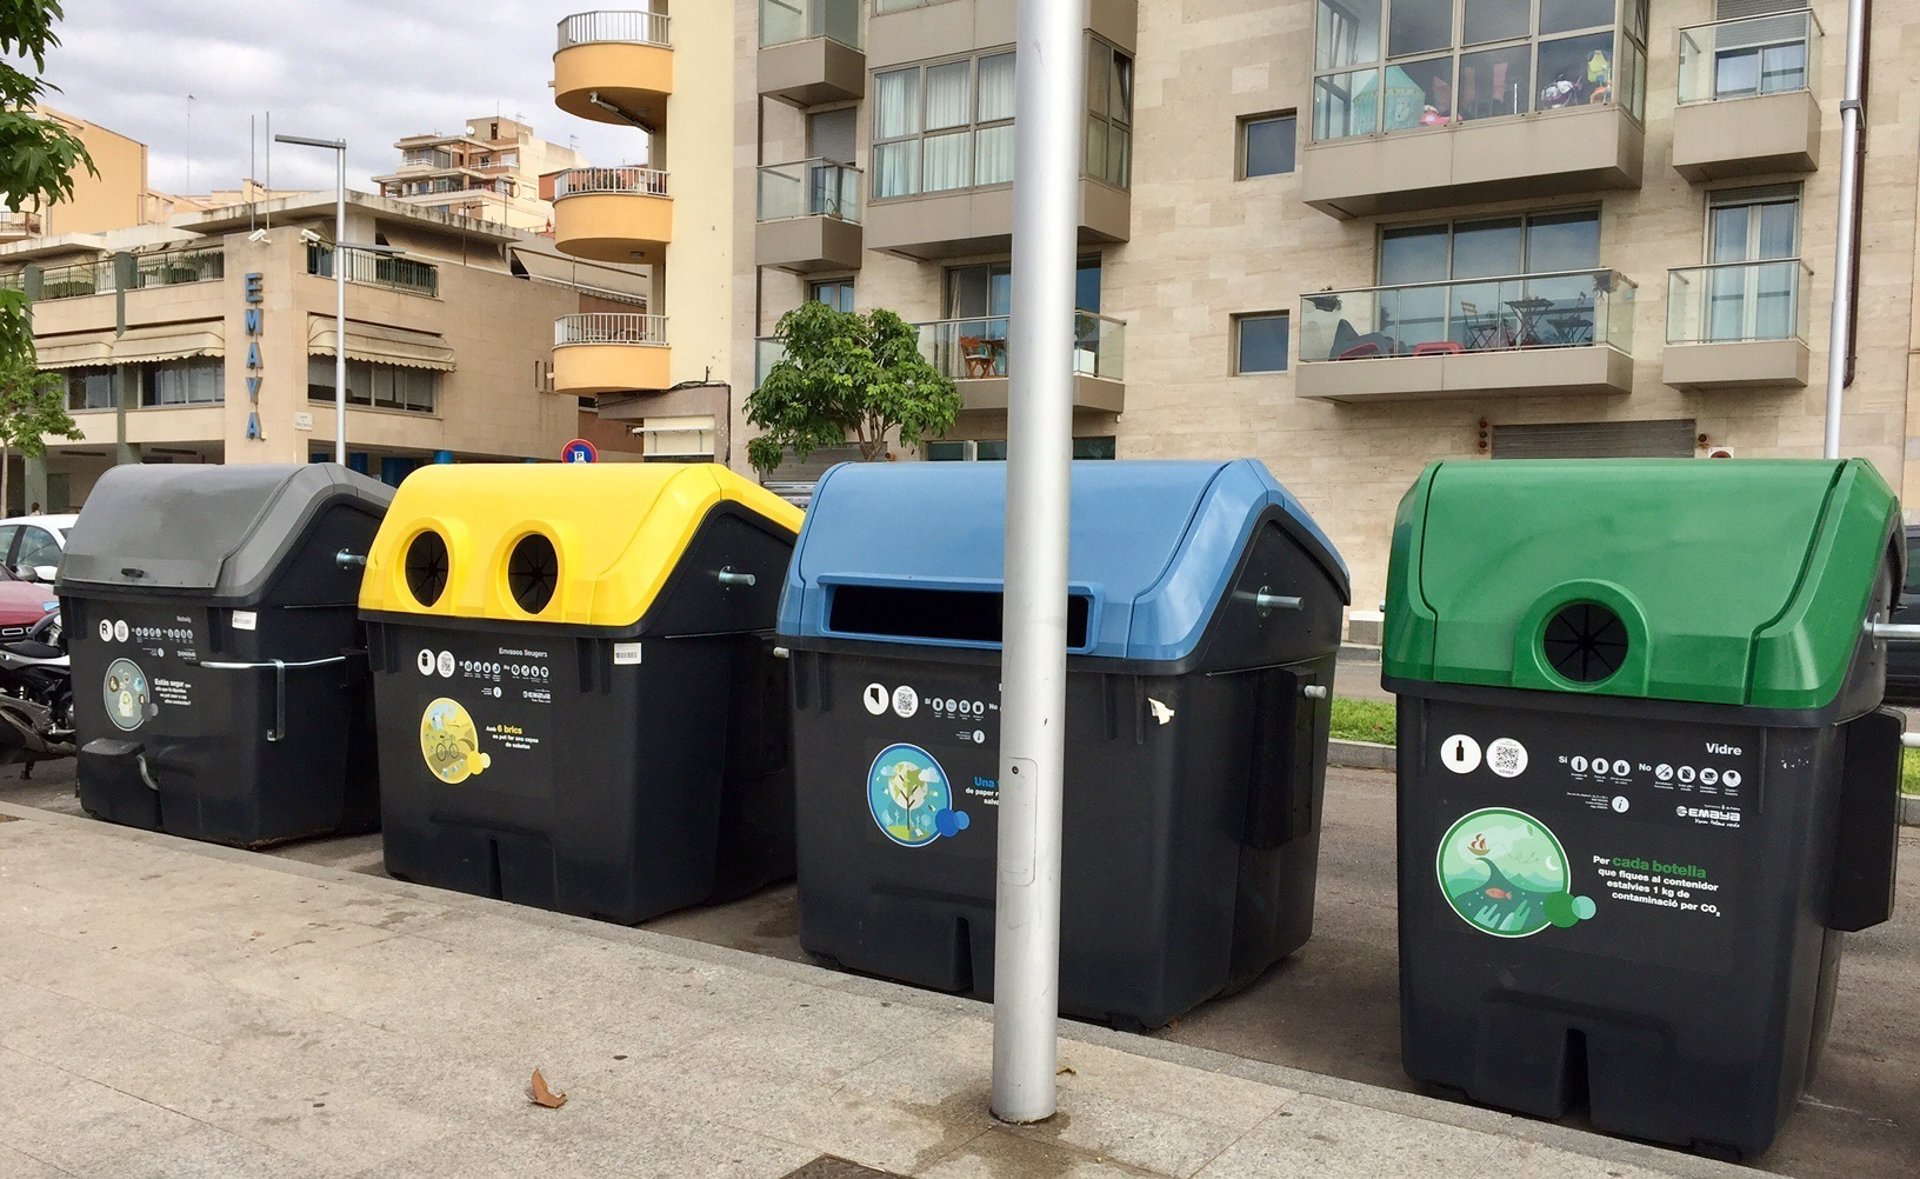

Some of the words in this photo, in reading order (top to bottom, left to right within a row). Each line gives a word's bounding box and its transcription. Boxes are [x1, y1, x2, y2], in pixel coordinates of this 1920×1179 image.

[245, 272, 264, 439] EMAYA
[102, 624, 108, 634] R
[504, 725, 522, 734] brics
[1706, 742, 1742, 755] Vidre
[1639, 763, 1652, 771] No
[974, 776, 994, 787] Una
[1593, 855, 1610, 865] Per
[1612, 857, 1649, 870] cada
[1652, 860, 1706, 878] botella
[1598, 868, 1616, 877] que
[1619, 870, 1649, 881] fiques
[1663, 878, 1719, 892] contenidor
[1607, 880, 1650, 893] estalvies
[1662, 886, 1674, 897] kg
[1677, 890, 1690, 898] de
[1612, 892, 1678, 908] contaminació
[1680, 902, 1698, 910] per
